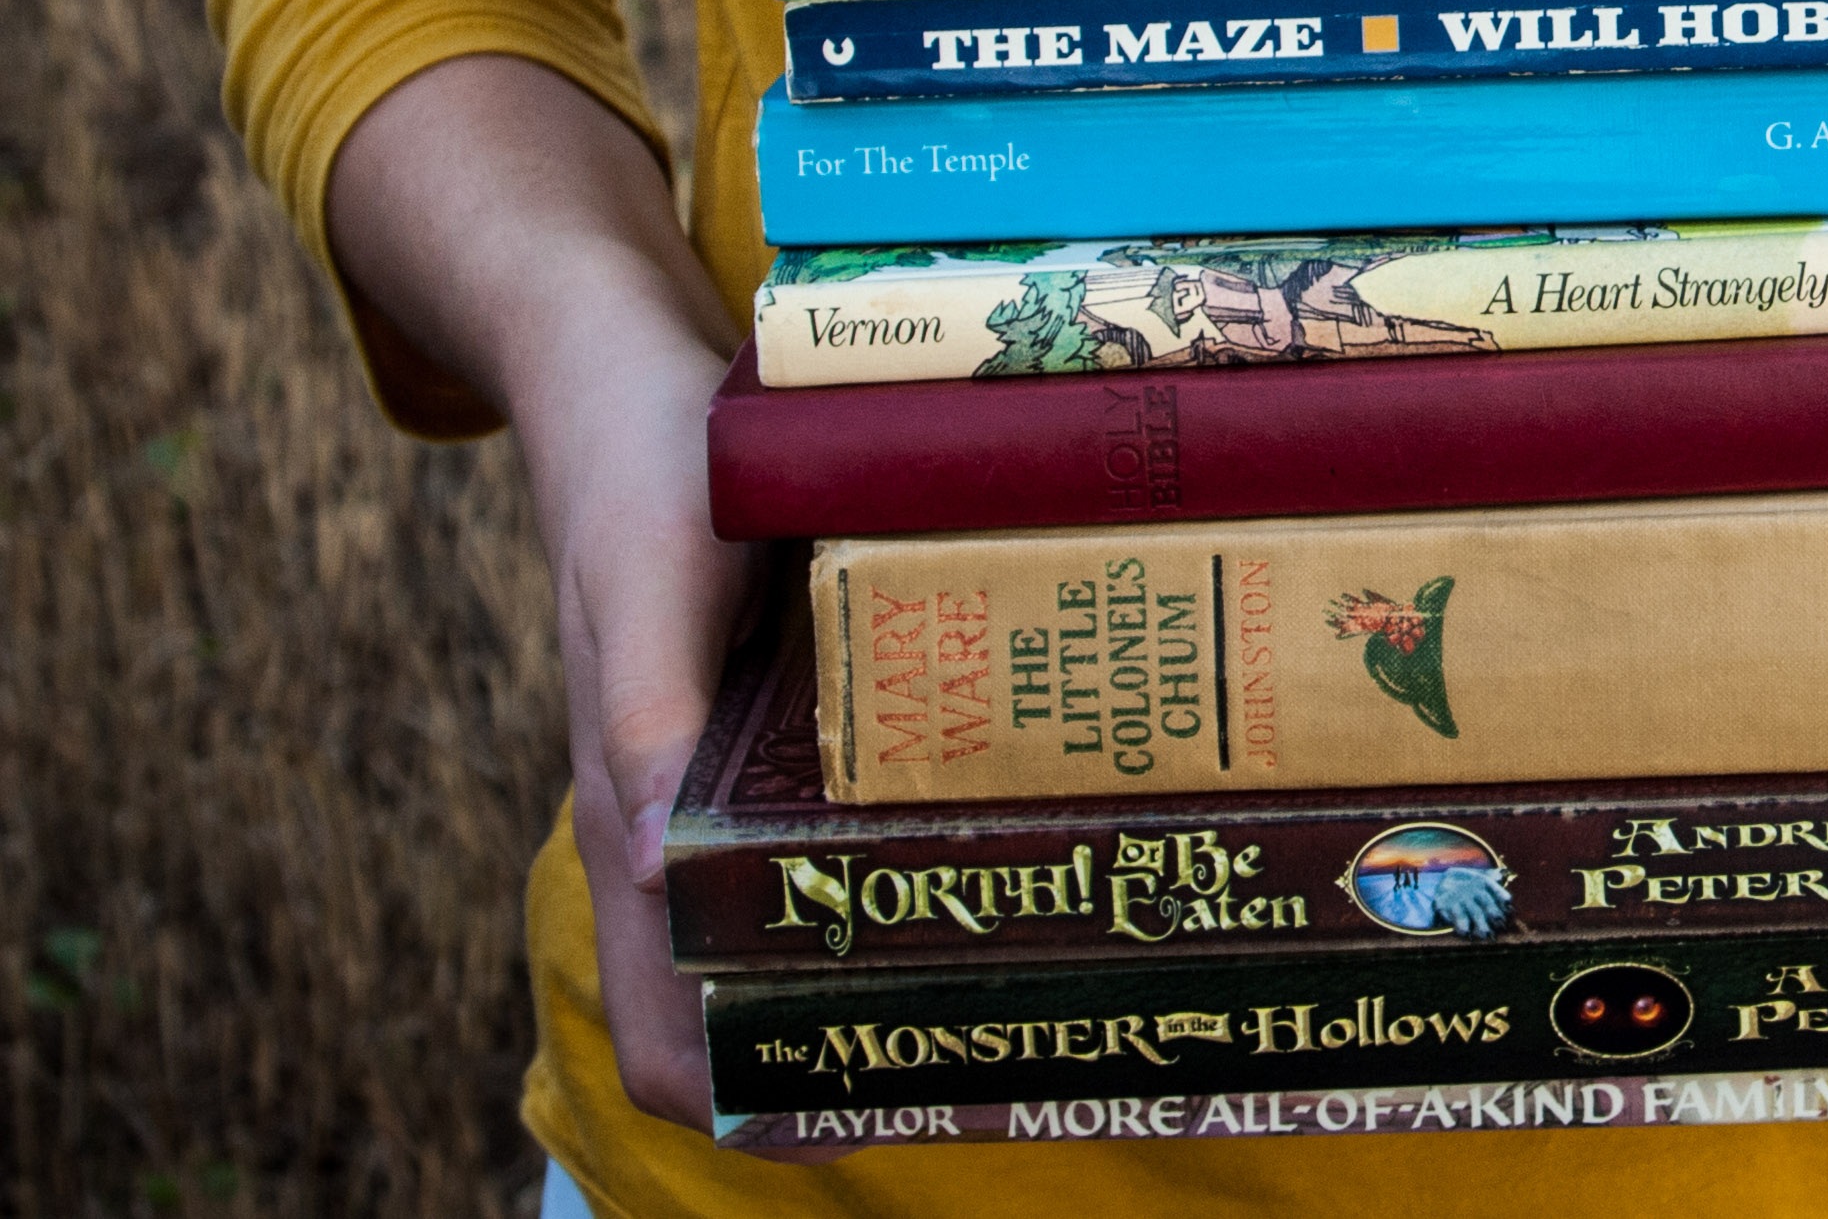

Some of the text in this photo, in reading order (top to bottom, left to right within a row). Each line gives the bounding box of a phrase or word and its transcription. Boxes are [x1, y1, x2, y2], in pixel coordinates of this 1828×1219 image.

[923, 16, 1325, 70] THE MAZE
[1437, 6, 1640, 52] WILL
[796, 141, 1031, 181] For The Temple
[1765, 121, 1800, 149] G.
[804, 306, 945, 349] Vernon
[1480, 280, 1517, 316] A
[1530, 272, 1643, 315] Heart
[1103, 385, 1144, 511] HOLY
[1143, 384, 1183, 510] BIBLE
[870, 585, 930, 767] MARY
[937, 589, 991, 766] WARE
[1009, 627, 1052, 729] THE
[1057, 579, 1104, 756] LITTLE
[1156, 592, 1202, 740] CHUM
[1238, 559, 1277, 769] JOHNSTON
[764, 843, 1095, 956] NORTH!
[1166, 829, 1264, 895] Be
[1106, 871, 1310, 943] Eaten
[755, 995, 1512, 1095] The MONSTER in the Hollows
[795, 1104, 961, 1139] TAYLOR
[1007, 1095, 1186, 1139] MORE
[1196, 1080, 1625, 1137] ALL-OF-A-KIND
